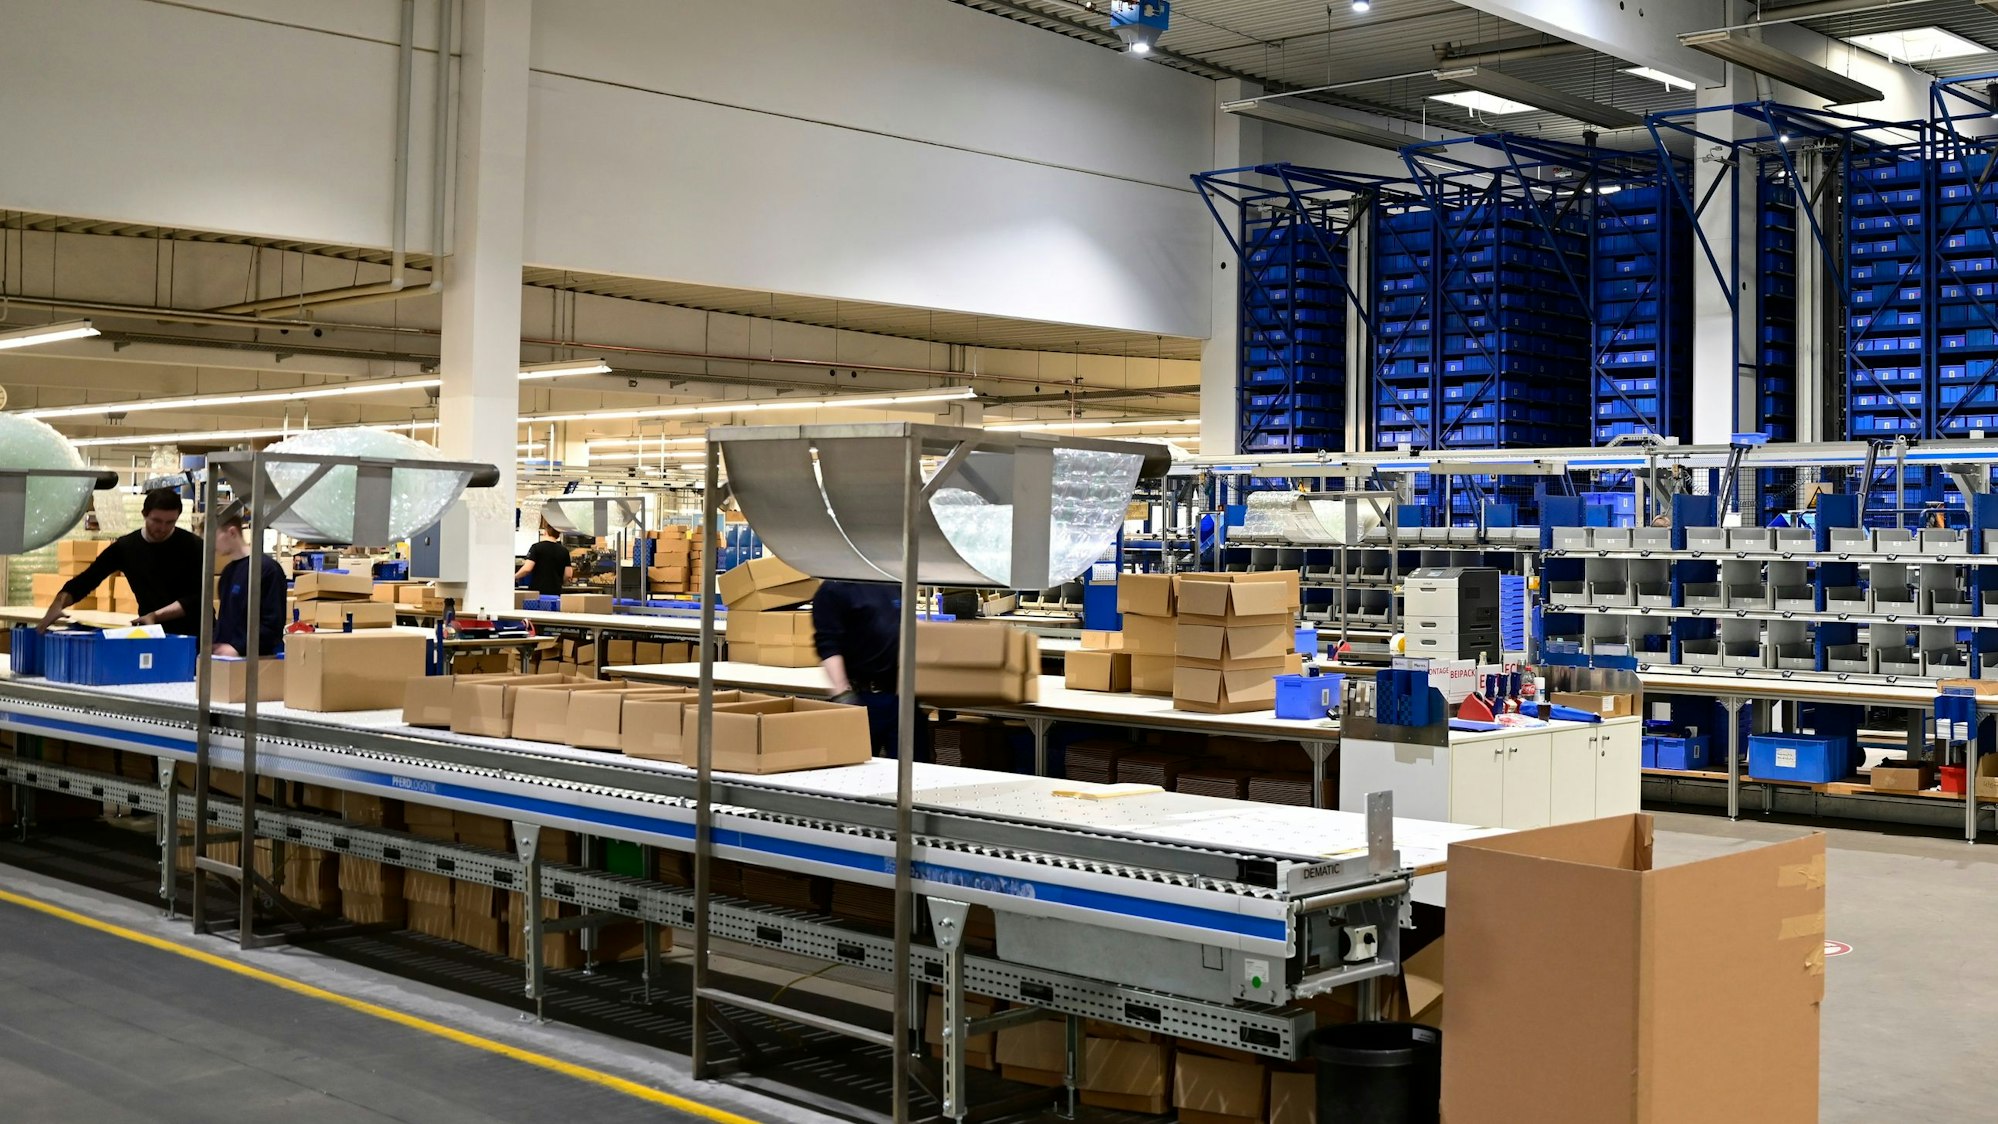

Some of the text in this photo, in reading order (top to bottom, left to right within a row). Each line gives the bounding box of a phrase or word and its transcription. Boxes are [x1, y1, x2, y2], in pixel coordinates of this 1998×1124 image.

[1429, 667, 1449, 676] ONTAGE
[1450, 668, 1476, 679] BEIPACK
[1303, 863, 1340, 880] DEMATIC
